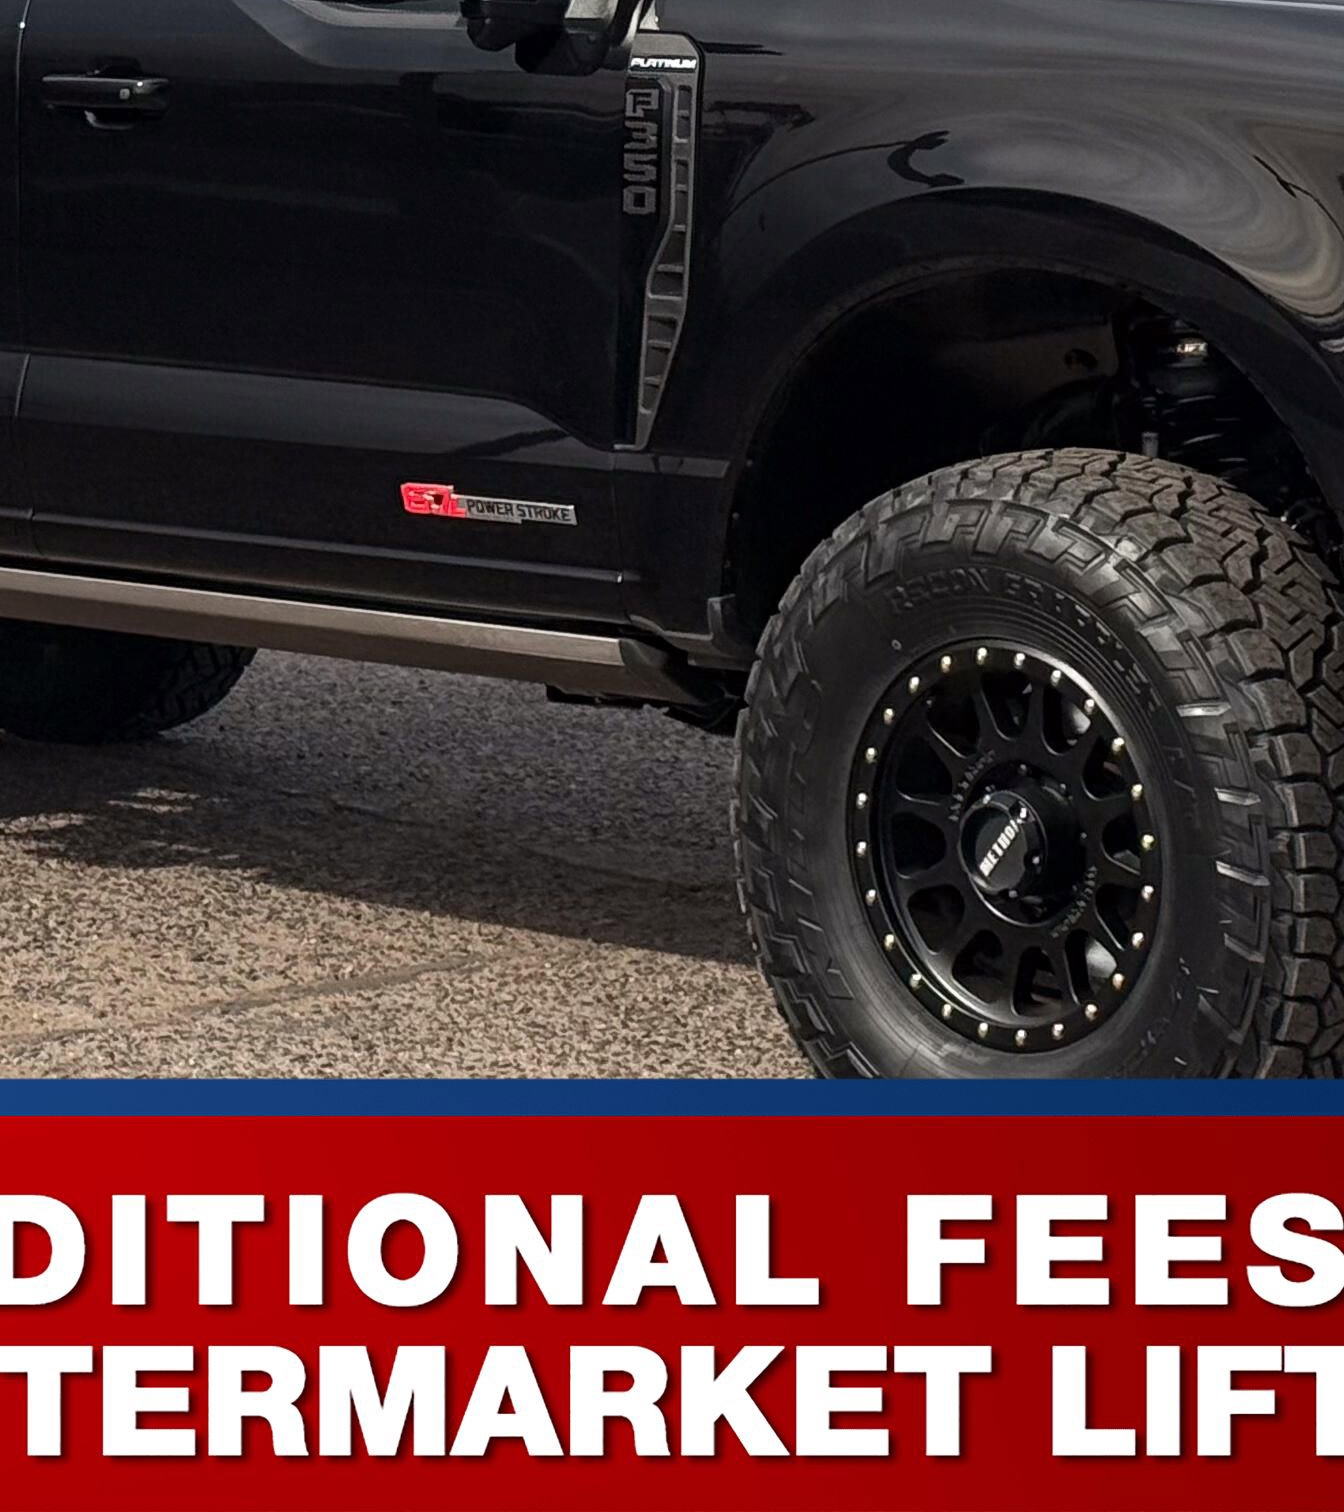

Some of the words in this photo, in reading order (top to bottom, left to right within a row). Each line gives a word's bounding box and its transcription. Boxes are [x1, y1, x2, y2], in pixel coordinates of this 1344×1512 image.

[630, 57, 697, 70] PLATINUM
[466, 498, 514, 517] POWER
[515, 503, 572, 522] STROKE
